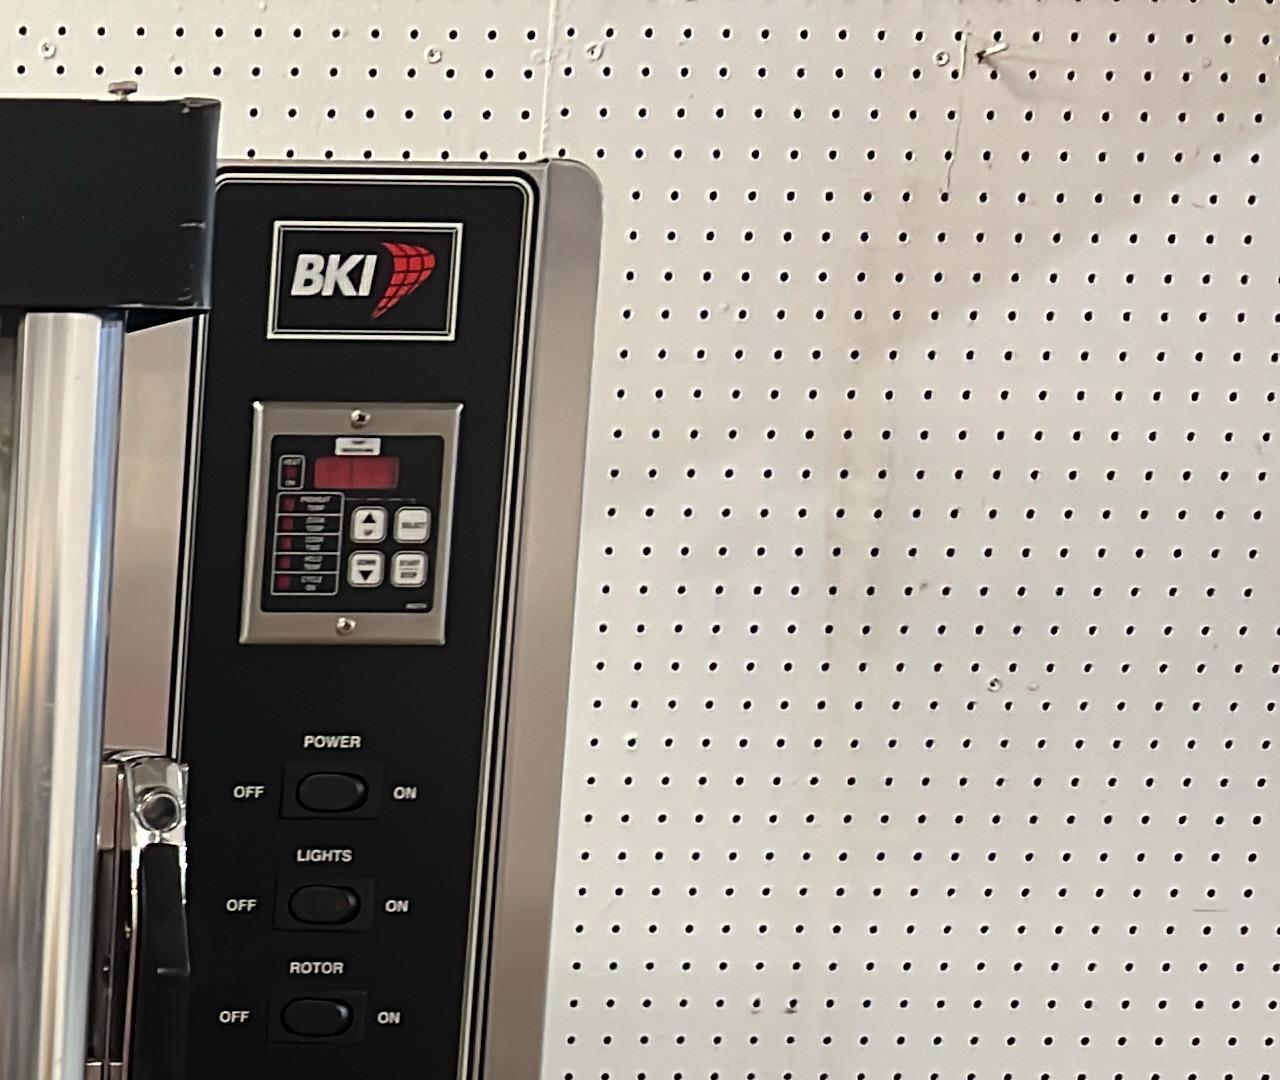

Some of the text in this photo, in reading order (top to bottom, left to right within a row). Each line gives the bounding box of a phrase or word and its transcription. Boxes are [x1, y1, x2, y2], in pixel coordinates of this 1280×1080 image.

[290, 253, 378, 296] BKI
[303, 735, 362, 749] POWER
[233, 785, 265, 799] OFF
[393, 786, 417, 800] ON
[296, 849, 353, 863] LIGHTS
[226, 898, 257, 912] OFF
[385, 899, 409, 913] ON
[289, 961, 344, 975] ROTOR
[219, 1010, 250, 1024] OFF
[377, 1010, 400, 1024] ON
